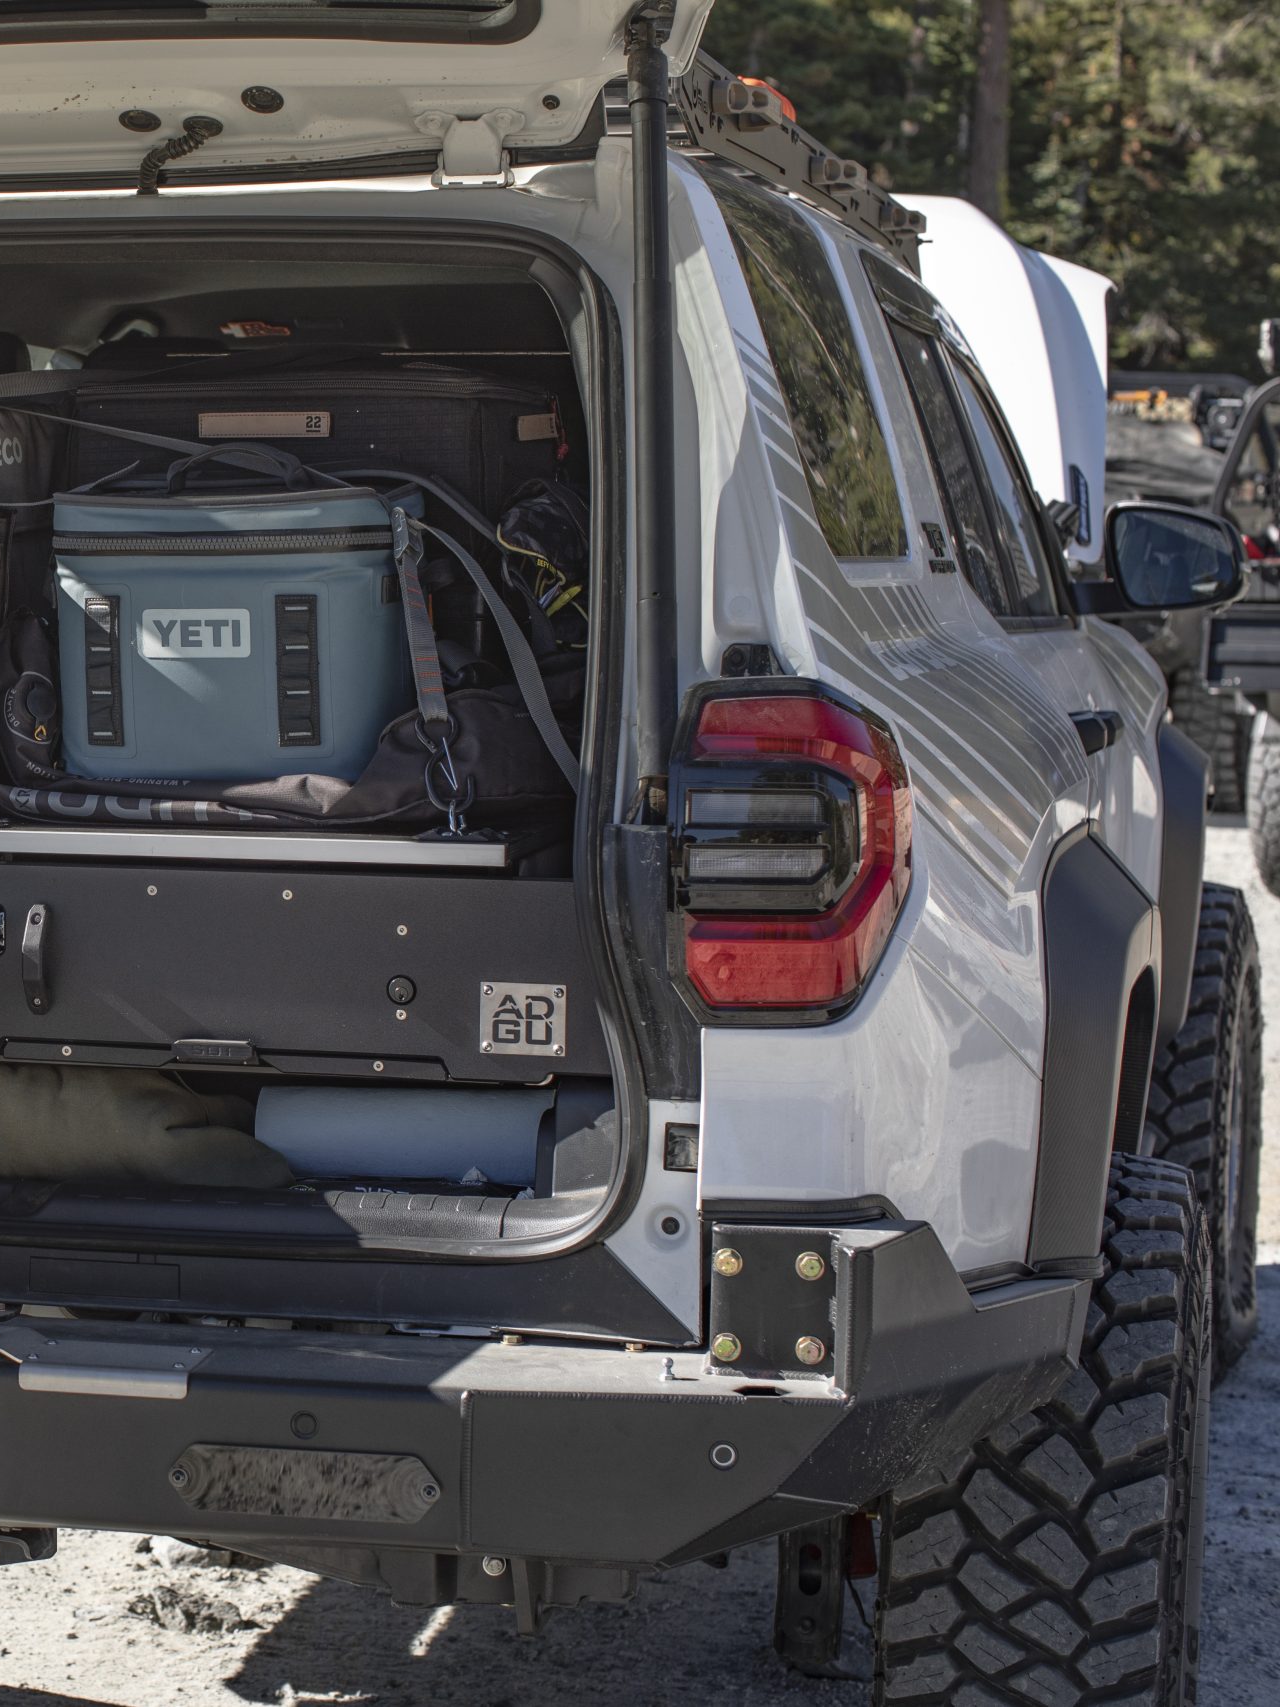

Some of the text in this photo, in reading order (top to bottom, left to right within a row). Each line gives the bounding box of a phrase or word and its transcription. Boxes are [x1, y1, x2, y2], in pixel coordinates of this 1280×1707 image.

[305, 415, 321, 430] 22
[152, 620, 241, 647] YETI
[7, 687, 21, 727] DEFLATE
[492, 994, 554, 1021] AD
